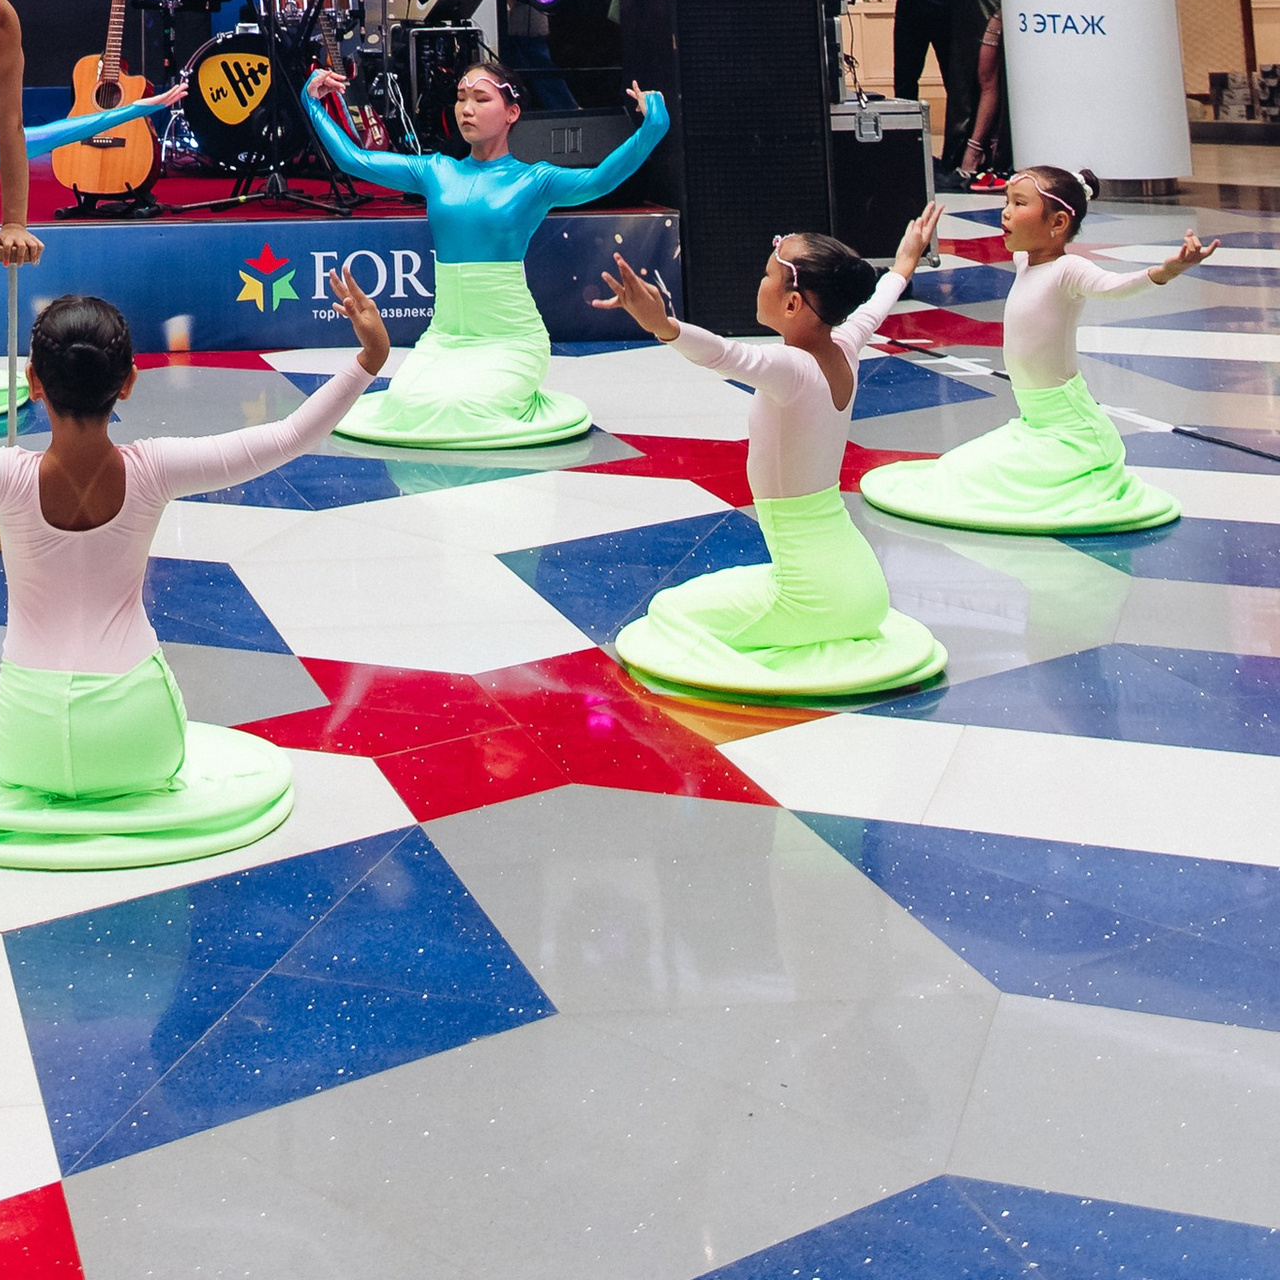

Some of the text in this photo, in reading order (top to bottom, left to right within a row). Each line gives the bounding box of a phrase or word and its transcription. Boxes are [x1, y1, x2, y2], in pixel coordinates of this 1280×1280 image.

[1019, 13, 1107, 35] 3 ЭТАЖ
[310, 249, 436, 300] FOR
